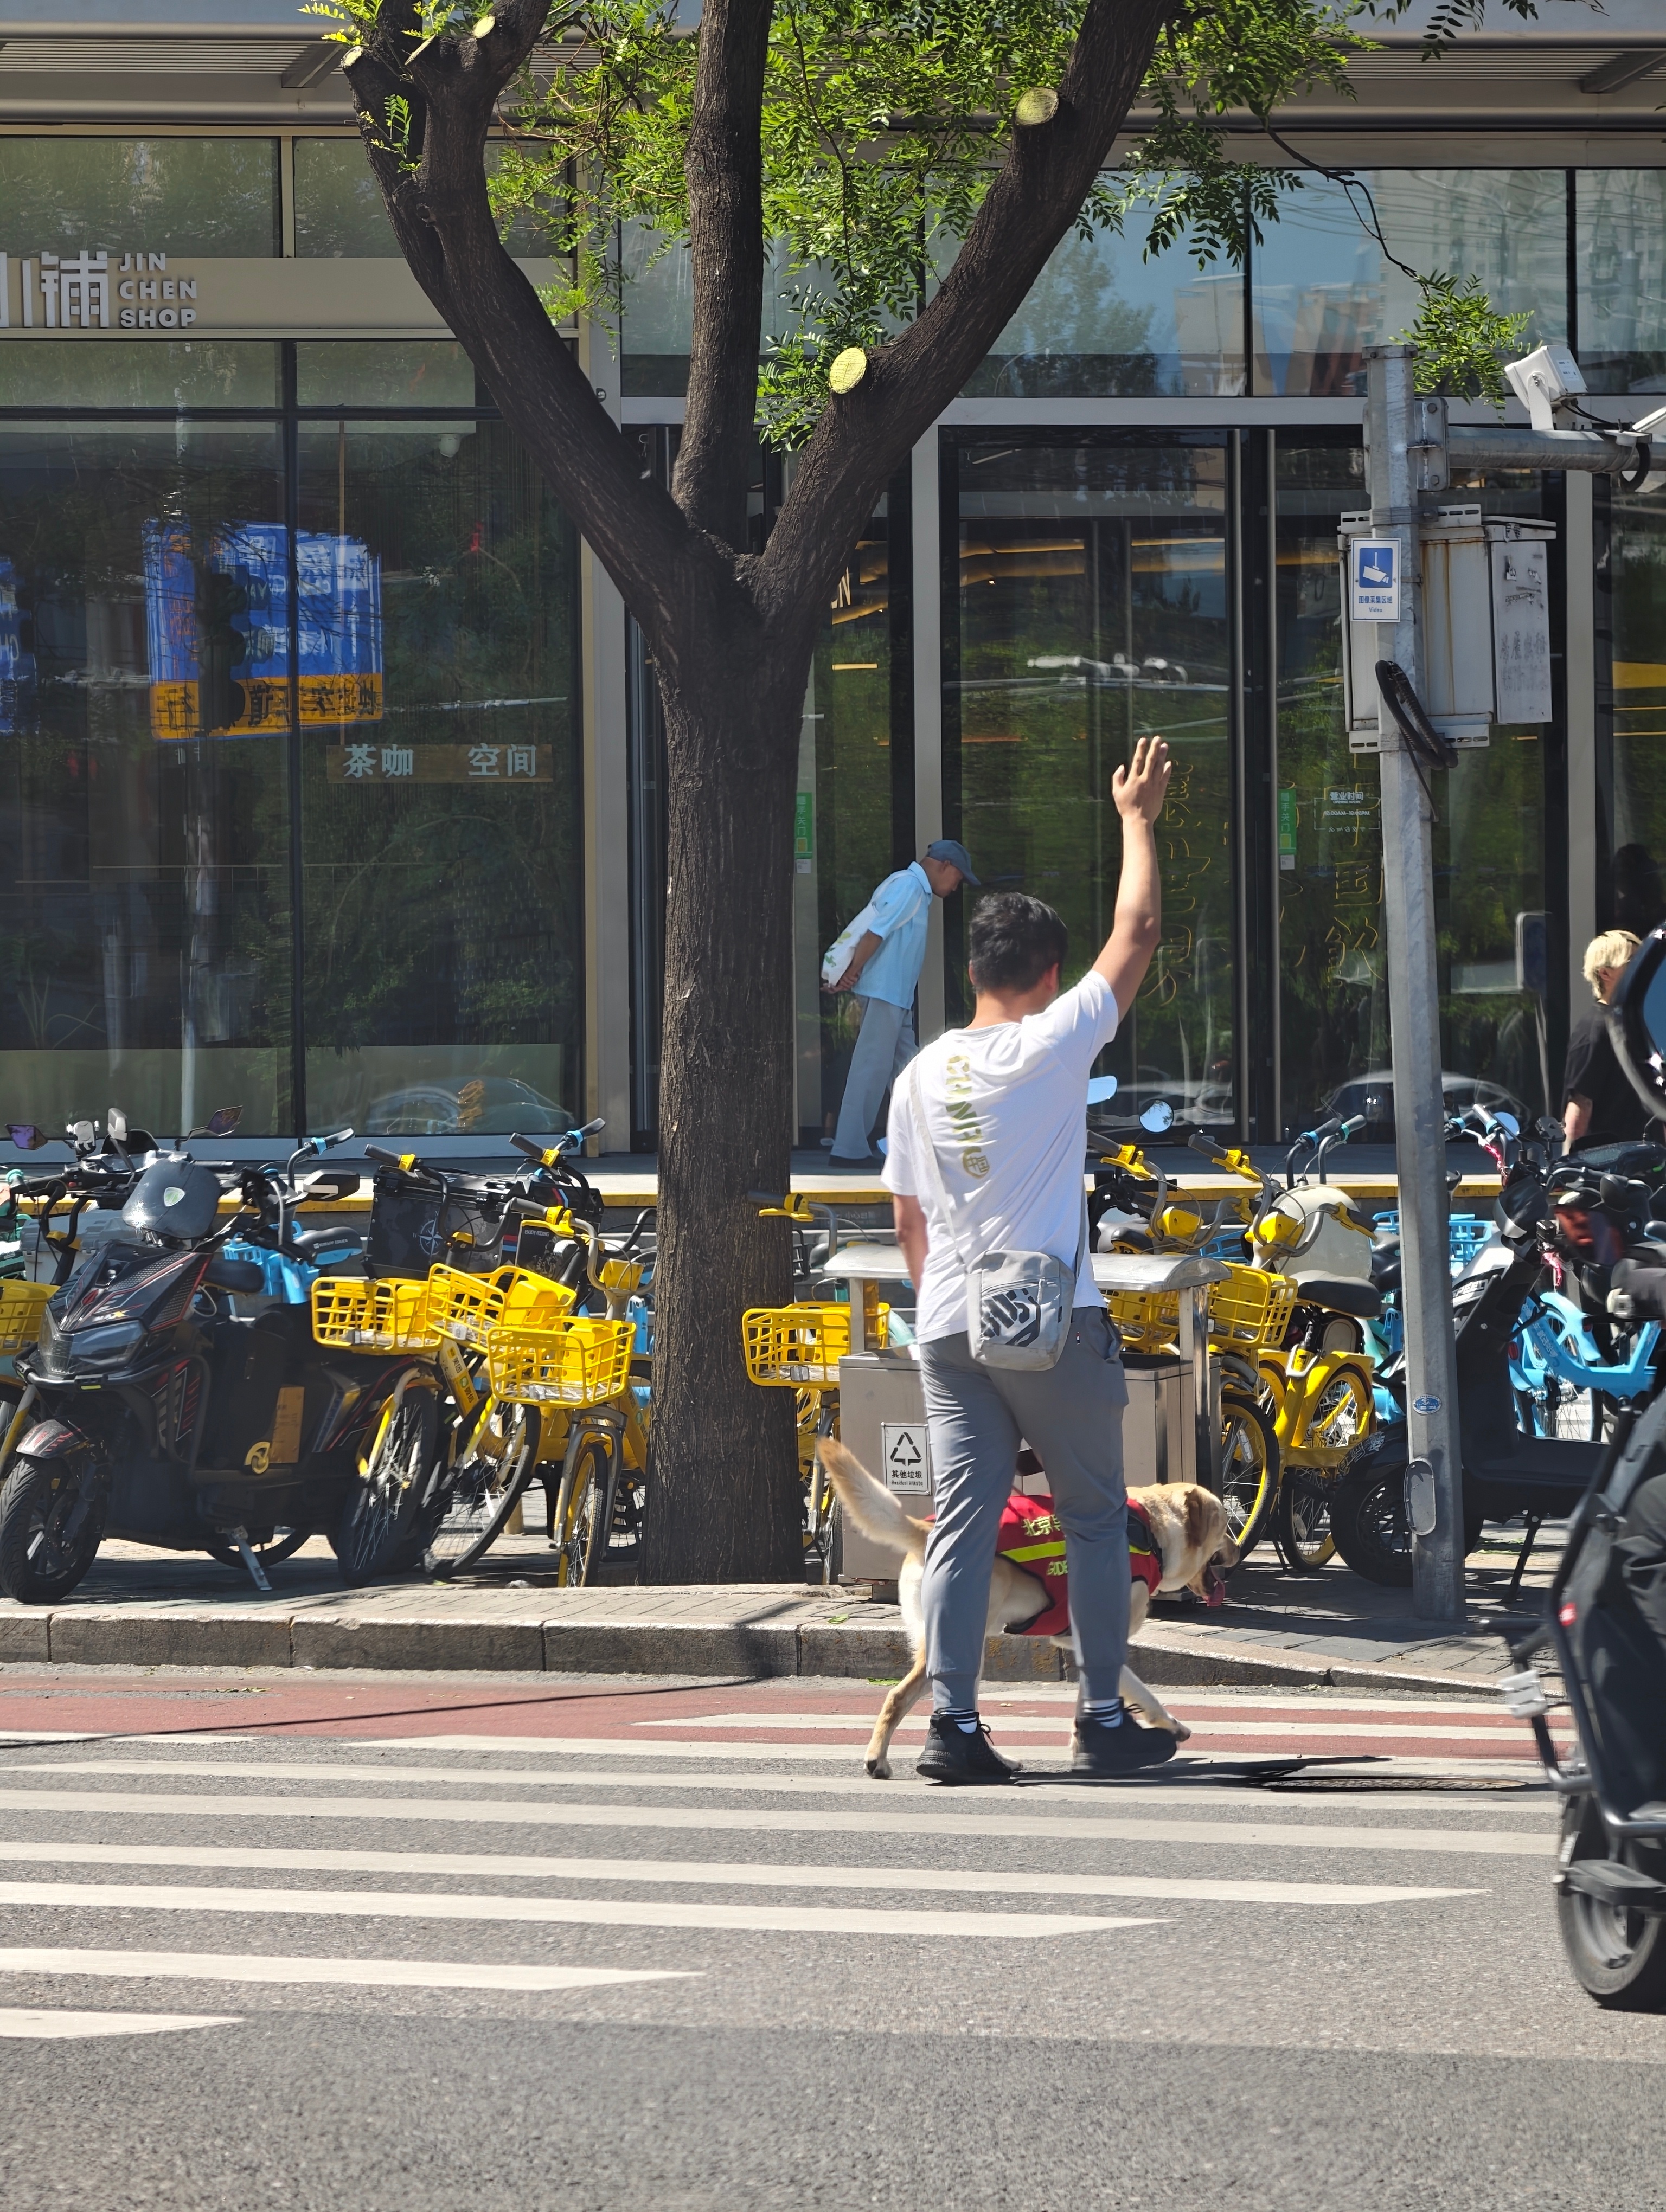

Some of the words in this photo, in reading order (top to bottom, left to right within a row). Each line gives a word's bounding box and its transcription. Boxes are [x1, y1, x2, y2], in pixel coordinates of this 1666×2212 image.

[119, 253, 166, 272] JIN
[119, 281, 197, 300] CHEN
[120, 309, 197, 328] SHOP
[1359, 595, 1393, 604] 图像采集区域
[342, 743, 414, 779] 茶咖
[467, 742, 537, 777] 空间
[1330, 790, 1364, 801] 营业时间
[891, 1469, 923, 1479] 其他垃圾
